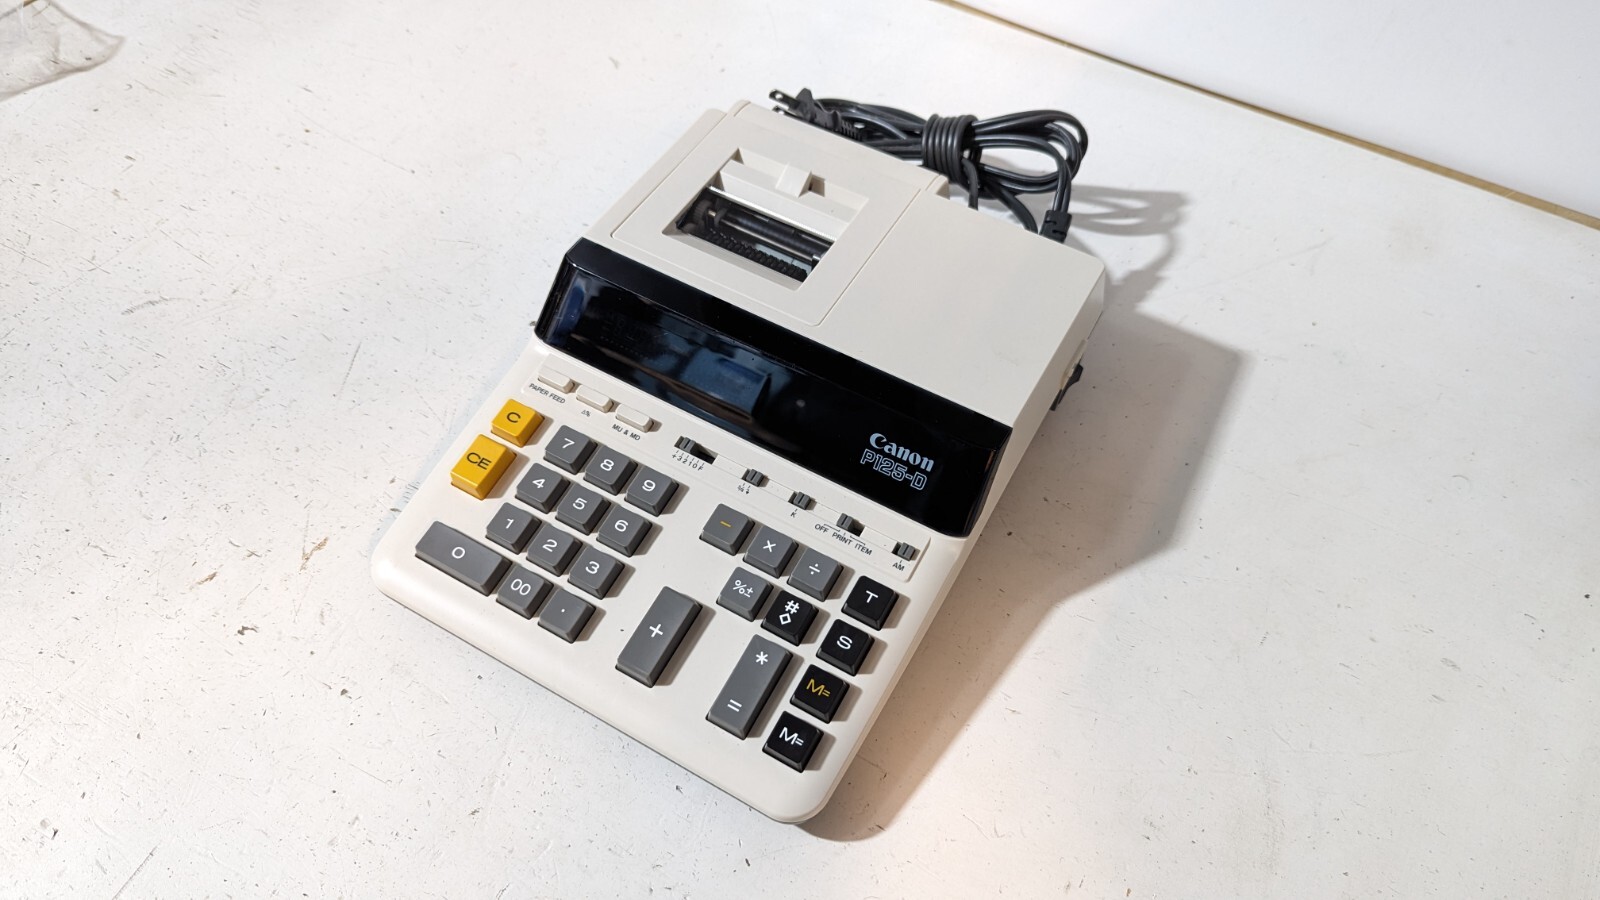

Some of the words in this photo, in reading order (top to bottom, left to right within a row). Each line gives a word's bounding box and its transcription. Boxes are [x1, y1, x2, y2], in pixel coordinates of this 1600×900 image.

[528, 383, 549, 396] PAPER
[549, 392, 566, 404] FEED
[506, 411, 522, 424] C
[612, 423, 623, 433] MU
[629, 432, 641, 441] MD
[562, 437, 575, 449] 7
[869, 433, 935, 472] Canon
[466, 452, 492, 470] CE
[600, 458, 615, 472] 8
[860, 448, 928, 491] P125-D
[532, 478, 546, 489] 4
[641, 479, 656, 492] 9
[572, 497, 588, 510] 5
[505, 518, 514, 529] 1
[614, 519, 629, 532] 6
[542, 539, 558, 553] 2
[814, 523, 829, 534] OFF
[831, 531, 853, 546] PRINT
[854, 541, 873, 556] ITEM
[451, 546, 466, 559] 0
[585, 560, 600, 575] 3
[892, 562, 905, 572] AM
[510, 578, 531, 596] 00
[865, 590, 879, 604] T
[836, 635, 853, 650] S
